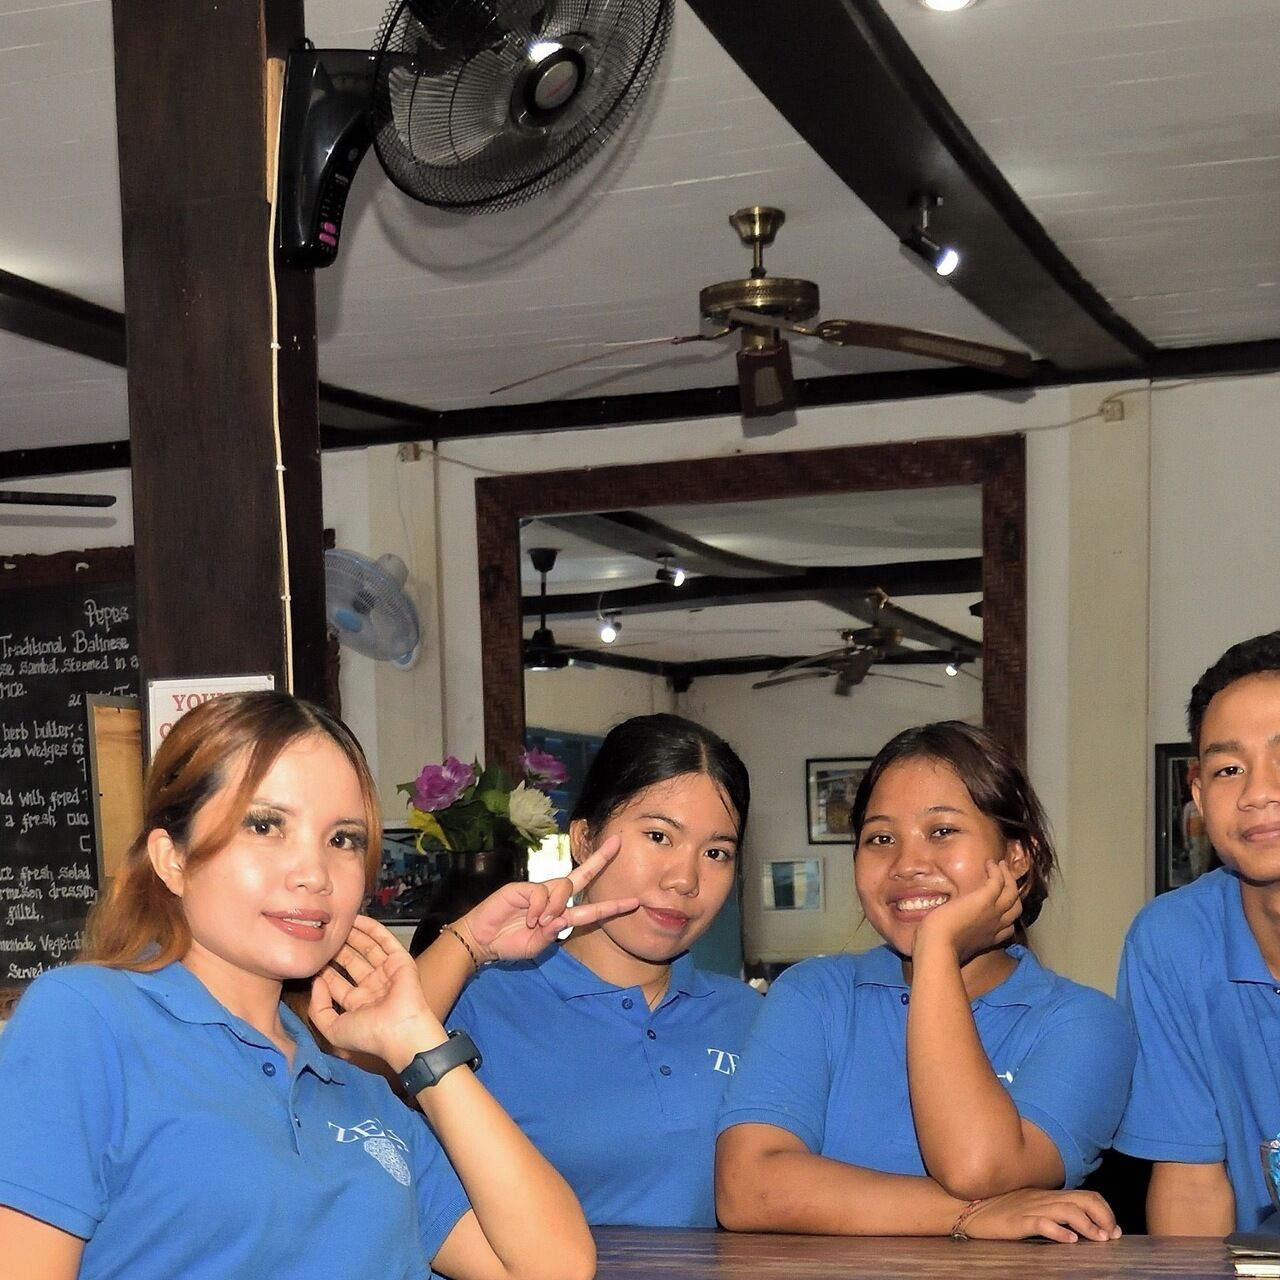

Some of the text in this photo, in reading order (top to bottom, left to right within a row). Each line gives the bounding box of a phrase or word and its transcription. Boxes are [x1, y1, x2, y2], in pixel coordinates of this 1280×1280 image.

[84, 599, 129, 632] Pepes
[72, 630, 129, 653] Balinese
[172, 692, 225, 711] YO
[2, 721, 29, 742] herb
[48, 787, 80, 812] fried
[20, 812, 56, 834] fresh
[19, 865, 54, 886] fresh
[706, 1048, 740, 1076] ZE
